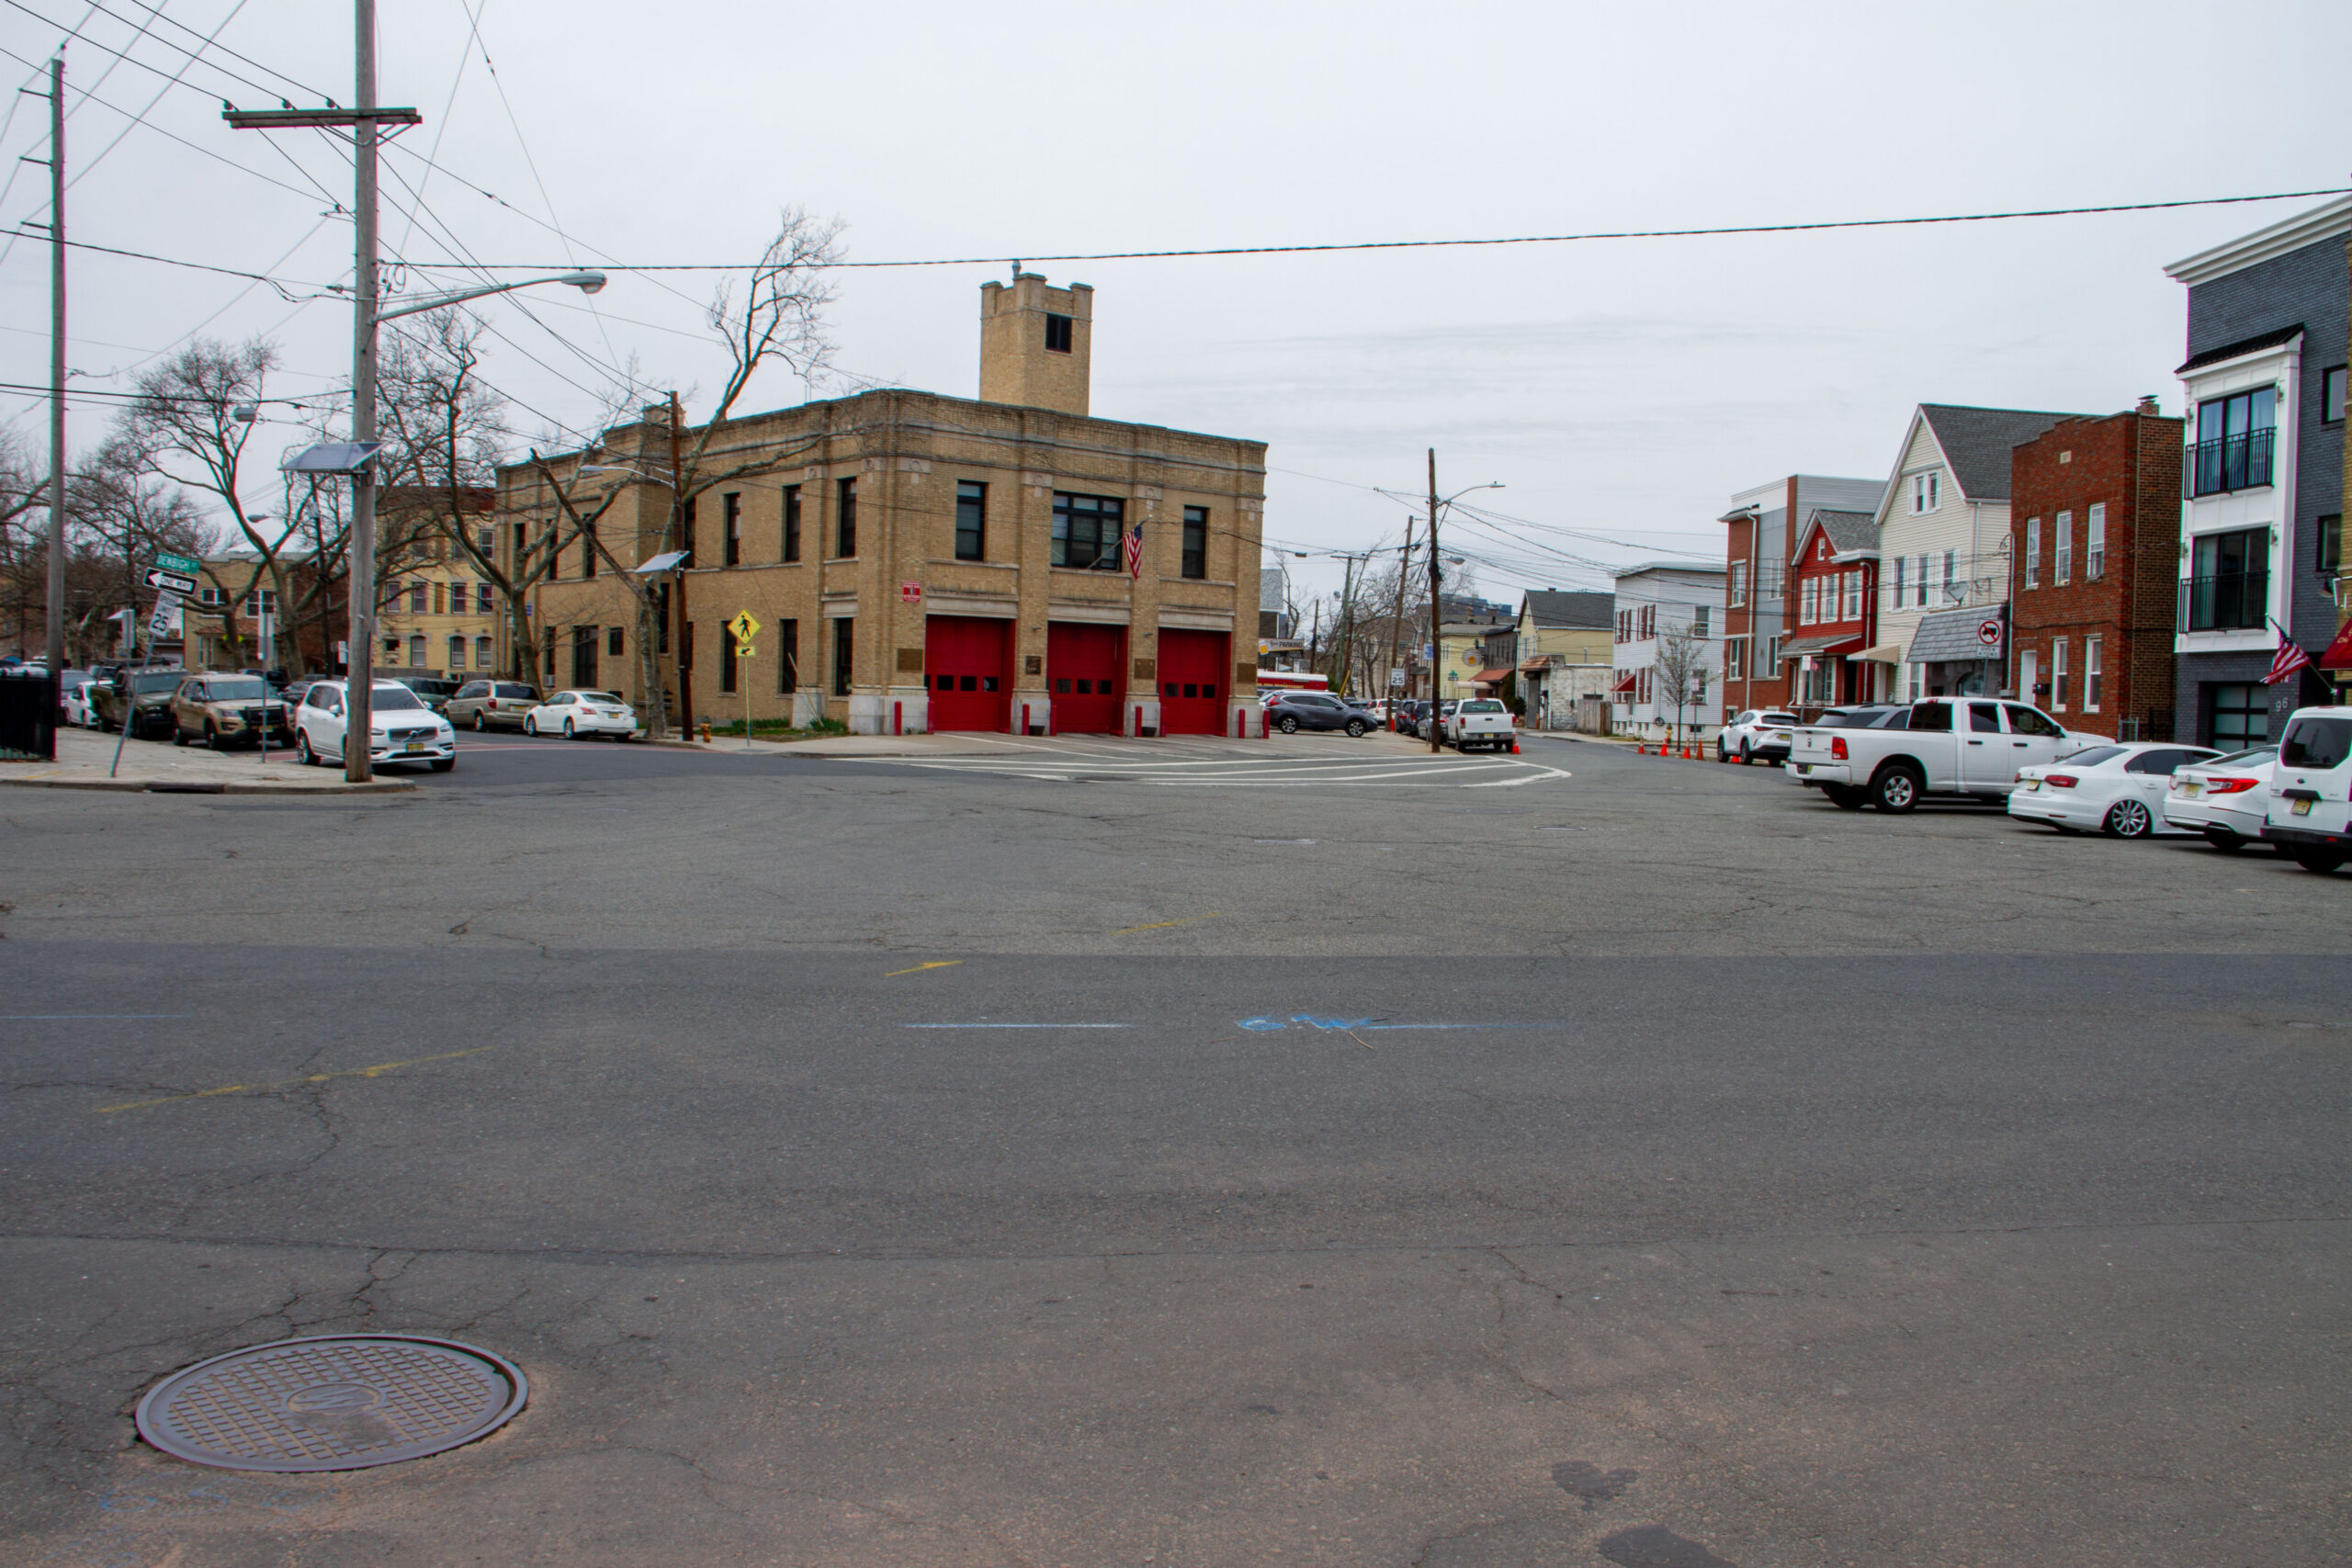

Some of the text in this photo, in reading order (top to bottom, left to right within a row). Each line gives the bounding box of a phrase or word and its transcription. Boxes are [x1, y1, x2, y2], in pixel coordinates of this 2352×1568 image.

[157, 554, 190, 569] DENBIGH
[161, 576, 191, 590] ONE WAY
[160, 594, 175, 606] SPEED
[152, 613, 169, 631] 25
[2275, 697, 2289, 712] 96
